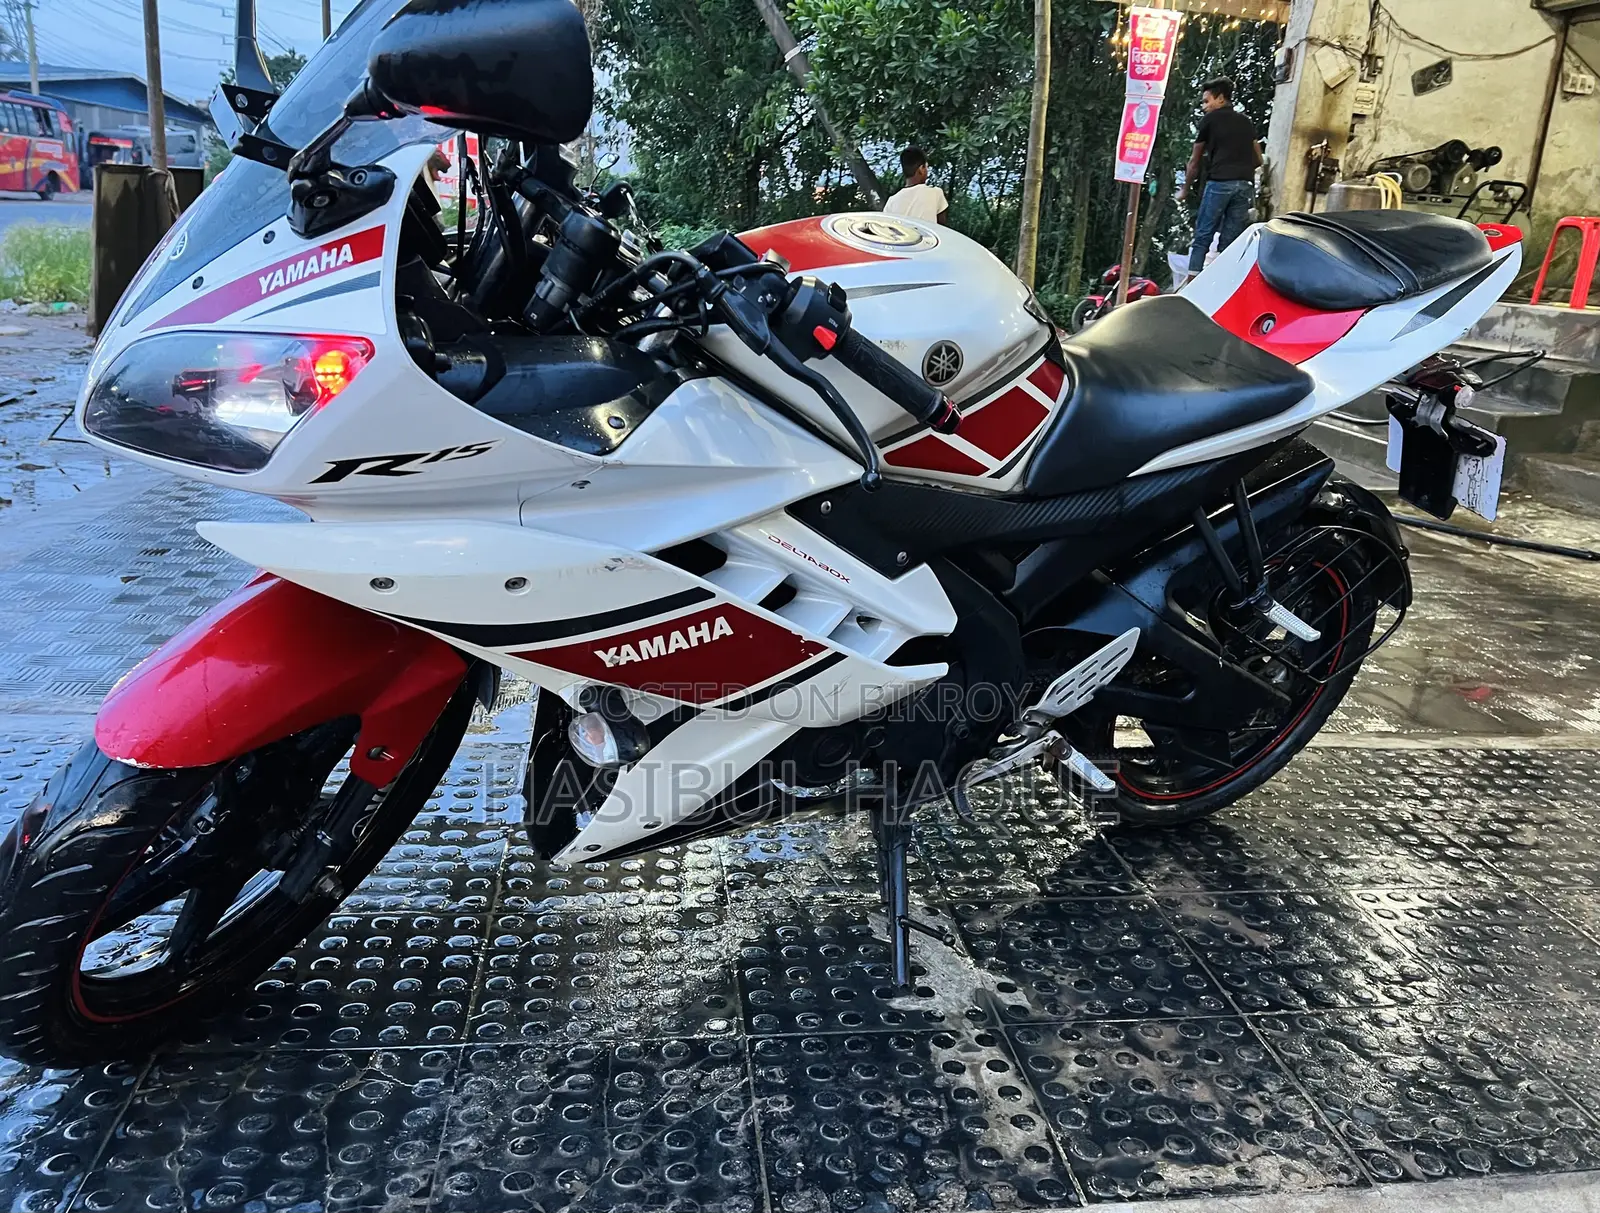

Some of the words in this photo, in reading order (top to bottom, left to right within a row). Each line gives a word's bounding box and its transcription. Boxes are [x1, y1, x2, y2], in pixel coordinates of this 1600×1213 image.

[1132, 48, 1167, 65] বিকাশ
[258, 243, 354, 296] YAMAHA
[306, 439, 500, 485] R15
[767, 534, 851, 584] DELTABOX
[593, 615, 734, 668] YAMAHA
